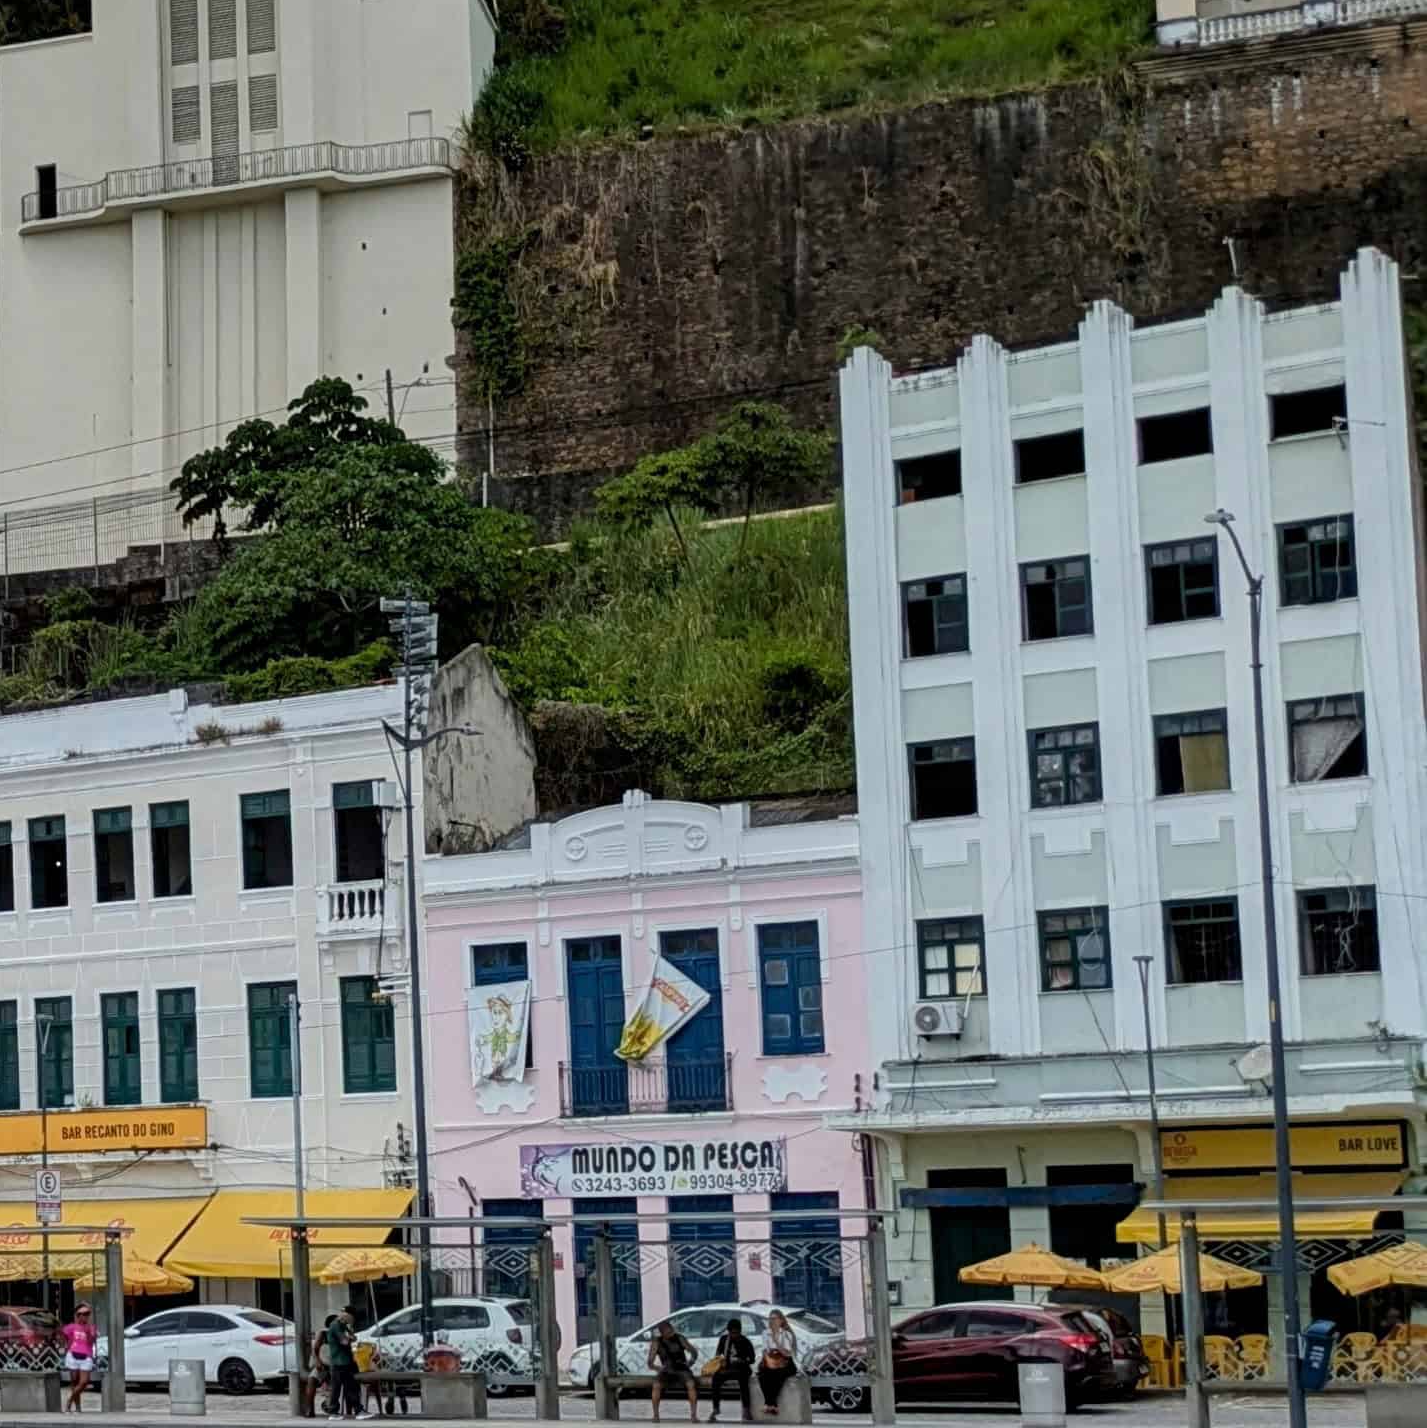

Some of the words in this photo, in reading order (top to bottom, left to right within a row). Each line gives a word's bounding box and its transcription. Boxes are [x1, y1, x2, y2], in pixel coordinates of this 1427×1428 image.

[61, 1125, 81, 1141] BAR
[84, 1123, 130, 1139] RECANTO
[133, 1123, 147, 1138] DO
[149, 1122, 176, 1137] GINO
[1338, 1138, 1363, 1152] BAR
[1366, 1136, 1398, 1151] LOVE
[572, 1145, 657, 1174] MUNDO
[663, 1144, 696, 1172] DA
[703, 1141, 775, 1171] PESCA
[585, 1176, 666, 1193] 3243-3693
